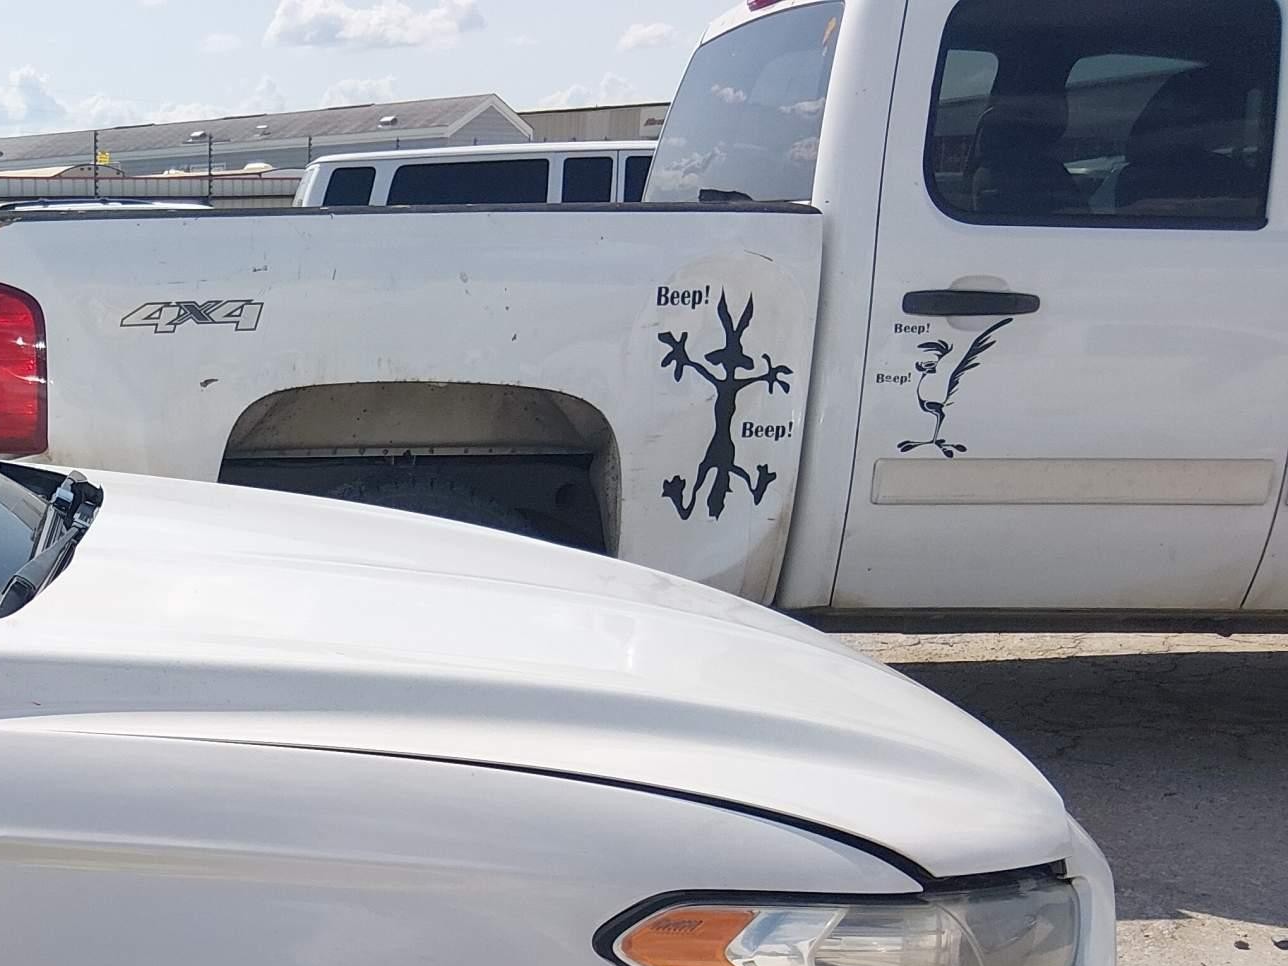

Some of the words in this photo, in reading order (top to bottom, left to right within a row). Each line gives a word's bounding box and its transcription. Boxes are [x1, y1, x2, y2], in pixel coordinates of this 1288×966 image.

[656, 285, 710, 310] Beep!
[894, 323, 930, 335] Beep!
[876, 372, 911, 385] Beep!
[741, 421, 793, 441] Beep!
